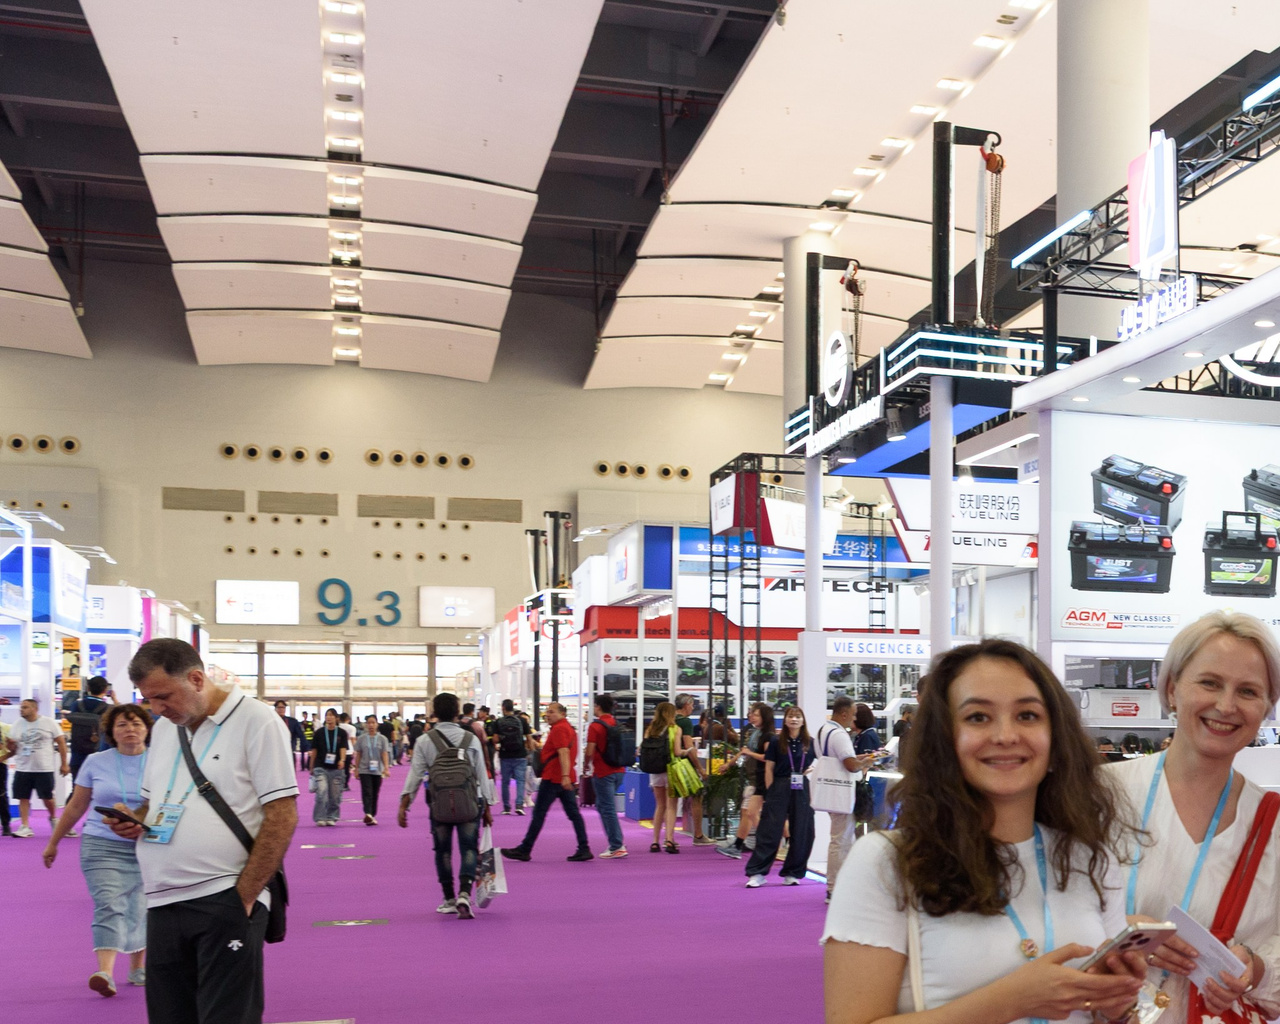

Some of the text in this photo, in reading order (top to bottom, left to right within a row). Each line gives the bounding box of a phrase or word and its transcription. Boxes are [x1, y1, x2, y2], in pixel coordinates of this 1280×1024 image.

[960, 511, 1019, 520] YUELING
[952, 537, 1008, 548] UELING
[769, 578, 894, 594] AHECH
[317, 578, 402, 627] 9.3
[1066, 610, 1107, 622] AGM
[833, 642, 925, 655] VIE SCIENCE &
